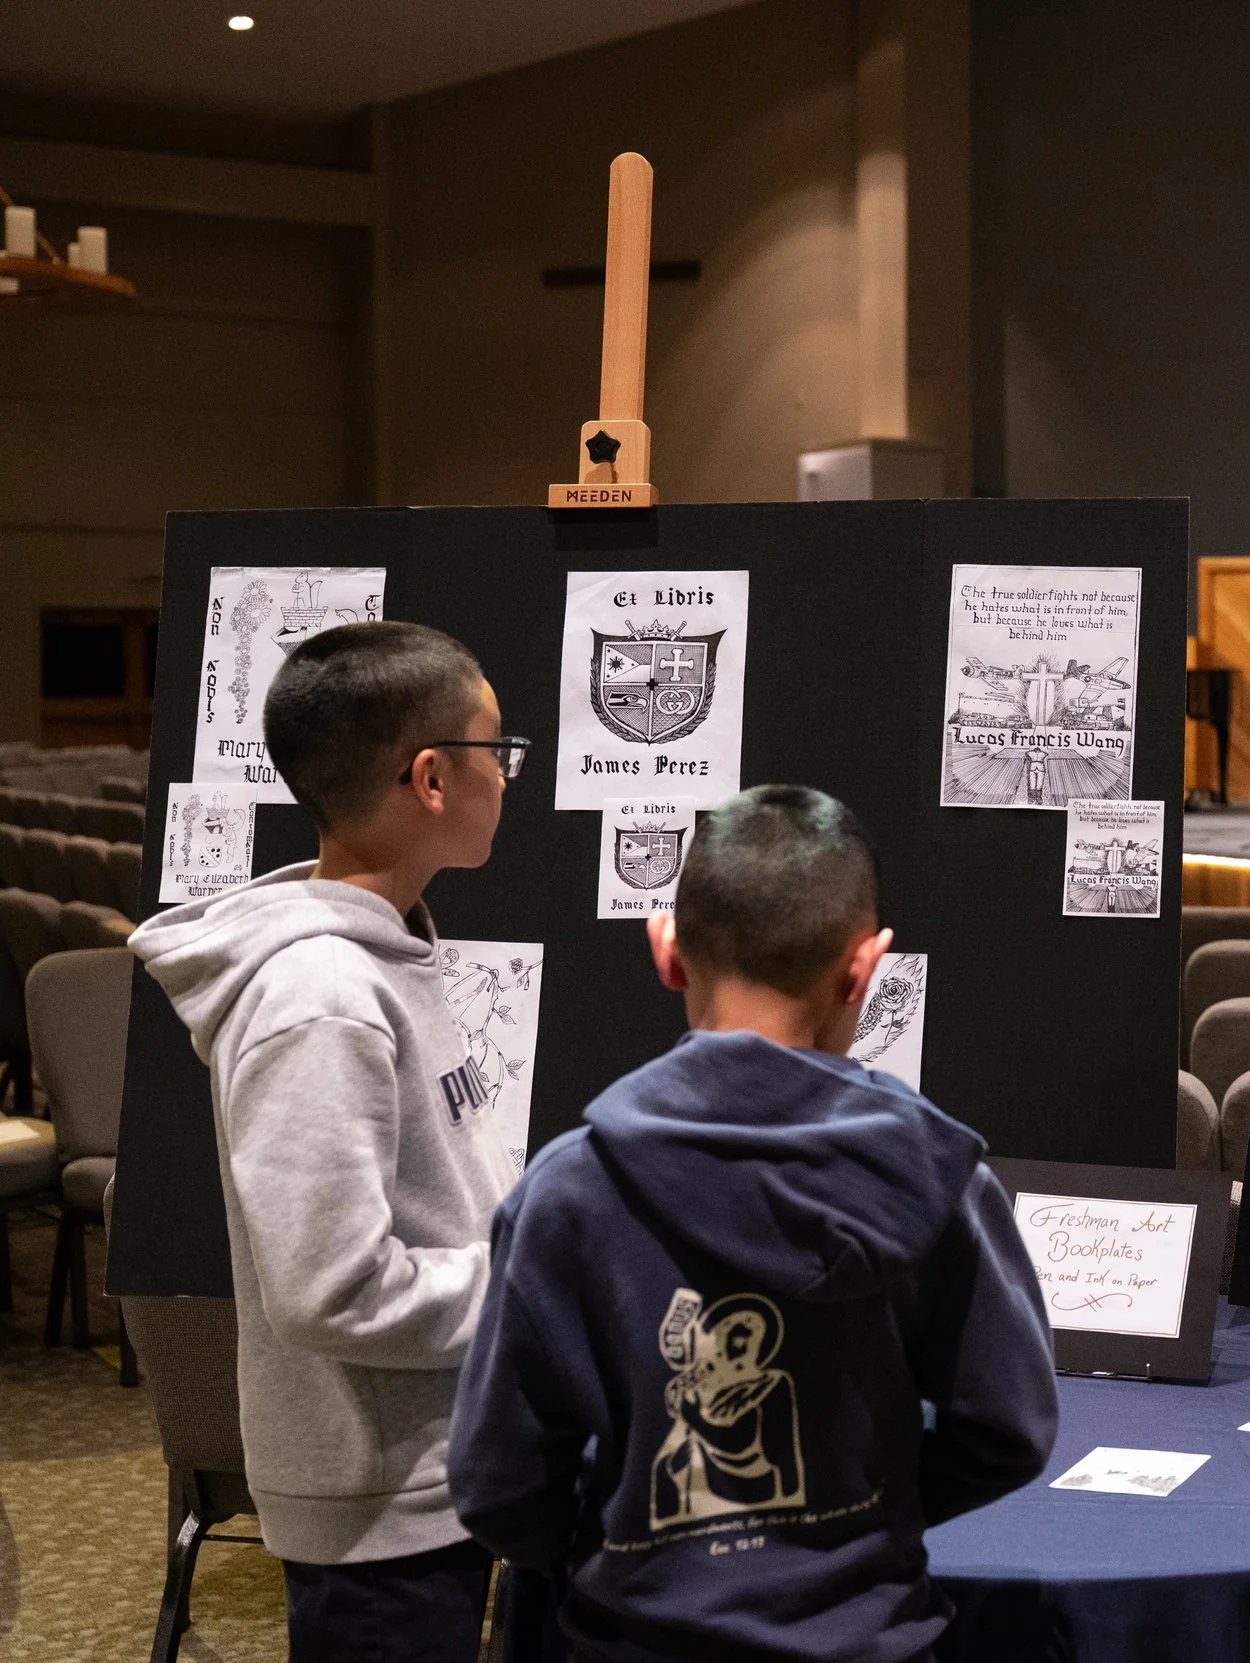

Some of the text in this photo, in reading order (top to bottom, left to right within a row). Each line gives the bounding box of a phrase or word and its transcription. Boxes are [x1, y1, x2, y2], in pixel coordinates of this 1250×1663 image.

[567, 490, 631, 502] MEEDEN
[614, 586, 713, 606] Ex Libris
[961, 585, 1135, 603] The true soldier fights not because
[964, 601, 1129, 617] he hates what is in front of him,
[973, 613, 1113, 630] but because he loves what is
[1009, 629, 1067, 641] behind him
[954, 727, 1124, 758] Lucas Francis Wang
[218, 740, 265, 763] Mary
[580, 754, 709, 776] James Perez
[244, 765, 277, 783] War
[644, 803, 676, 814] Libris
[176, 874, 199, 885] Mary
[1070, 874, 1156, 889] Lucas Francis Wang
[611, 899, 675, 910] James Pere
[1030, 1203, 1176, 1233] Freshman Art
[1059, 1269, 1080, 1282] and
[1112, 1278, 1123, 1286] on
[1128, 1273, 1158, 1289] Paper
